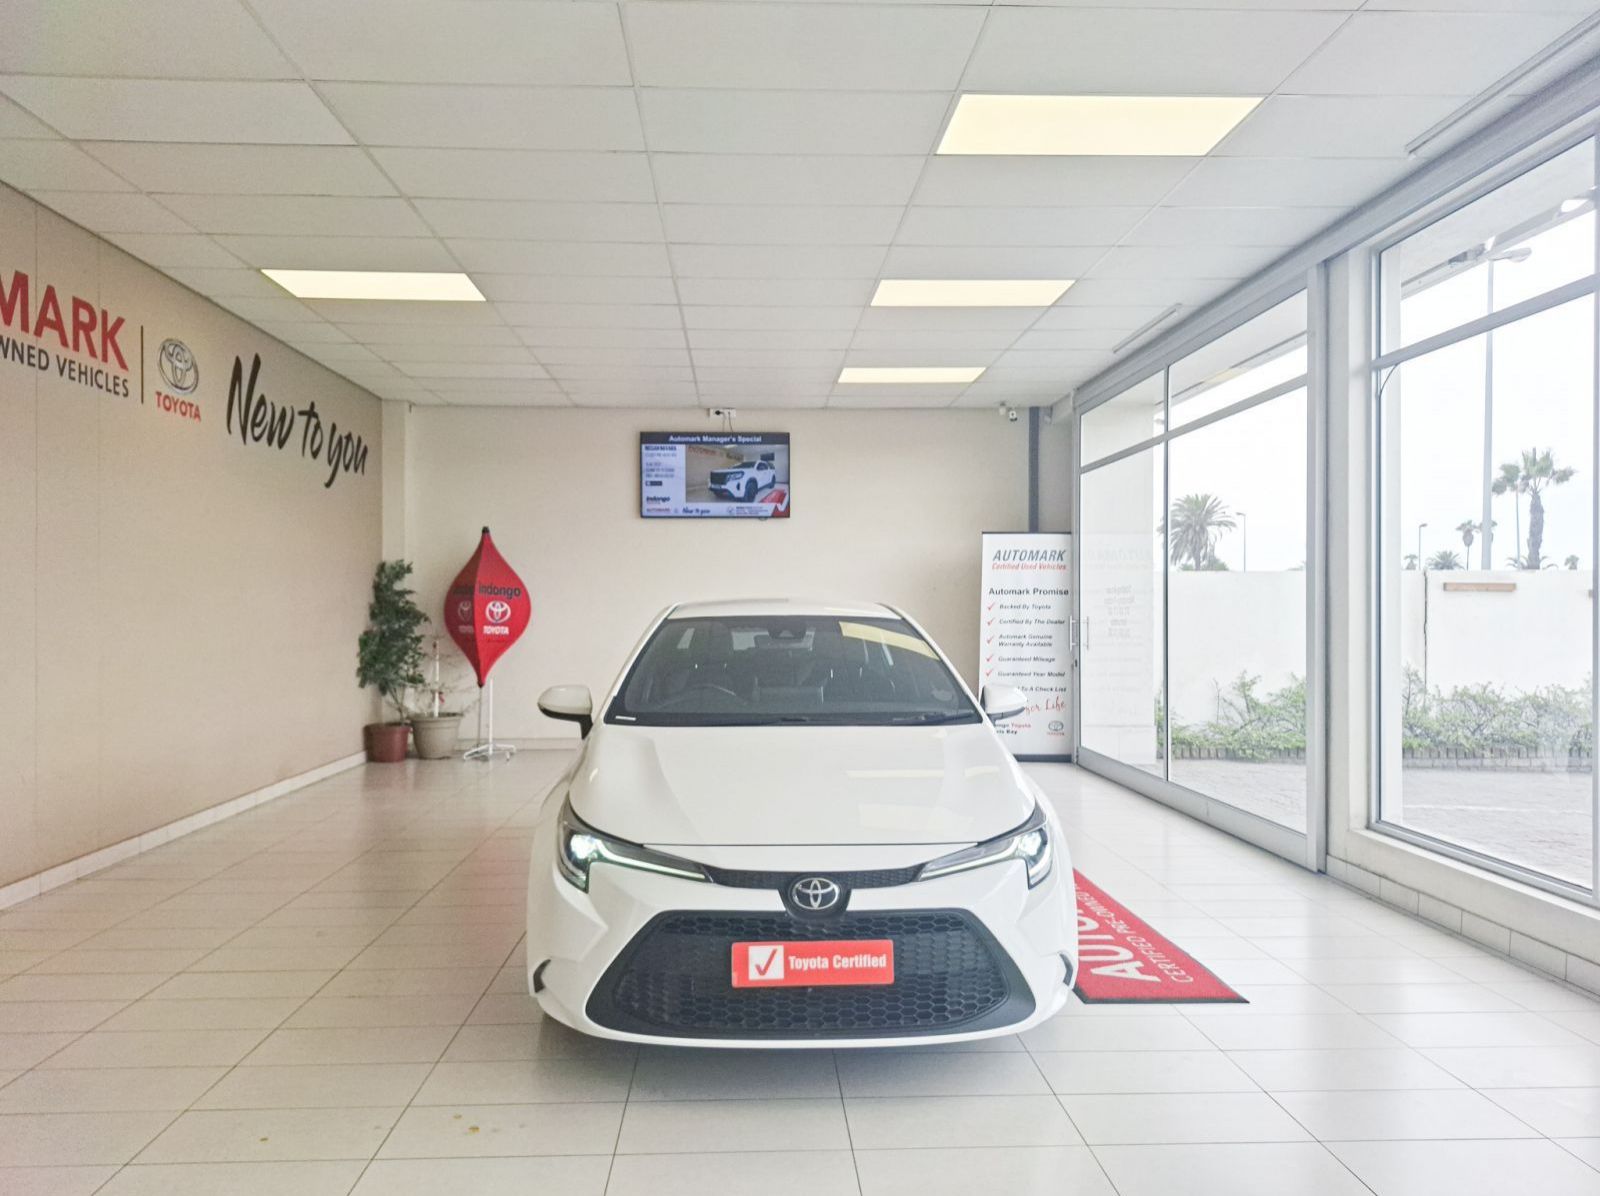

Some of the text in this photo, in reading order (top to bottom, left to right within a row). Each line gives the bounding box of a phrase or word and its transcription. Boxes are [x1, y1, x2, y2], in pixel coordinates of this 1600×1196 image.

[0, 269, 128, 371] MARK
[56, 354, 129, 398] VEHICLES
[155, 391, 201, 422] TOYOTA
[226, 353, 369, 488] New to you
[702, 435, 736, 443] Manager's
[737, 435, 762, 443] Special
[993, 549, 1066, 562] AUTOMARK
[1039, 563, 1067, 571] Vehicles
[989, 587, 1069, 596] Automark Promise
[1022, 603, 1030, 611] By
[1032, 603, 1051, 611] Toyota
[483, 625, 510, 636] TOYOTA
[788, 954, 887, 971] Toyota Certified
[1126, 935, 1194, 983] CERTIFIED
